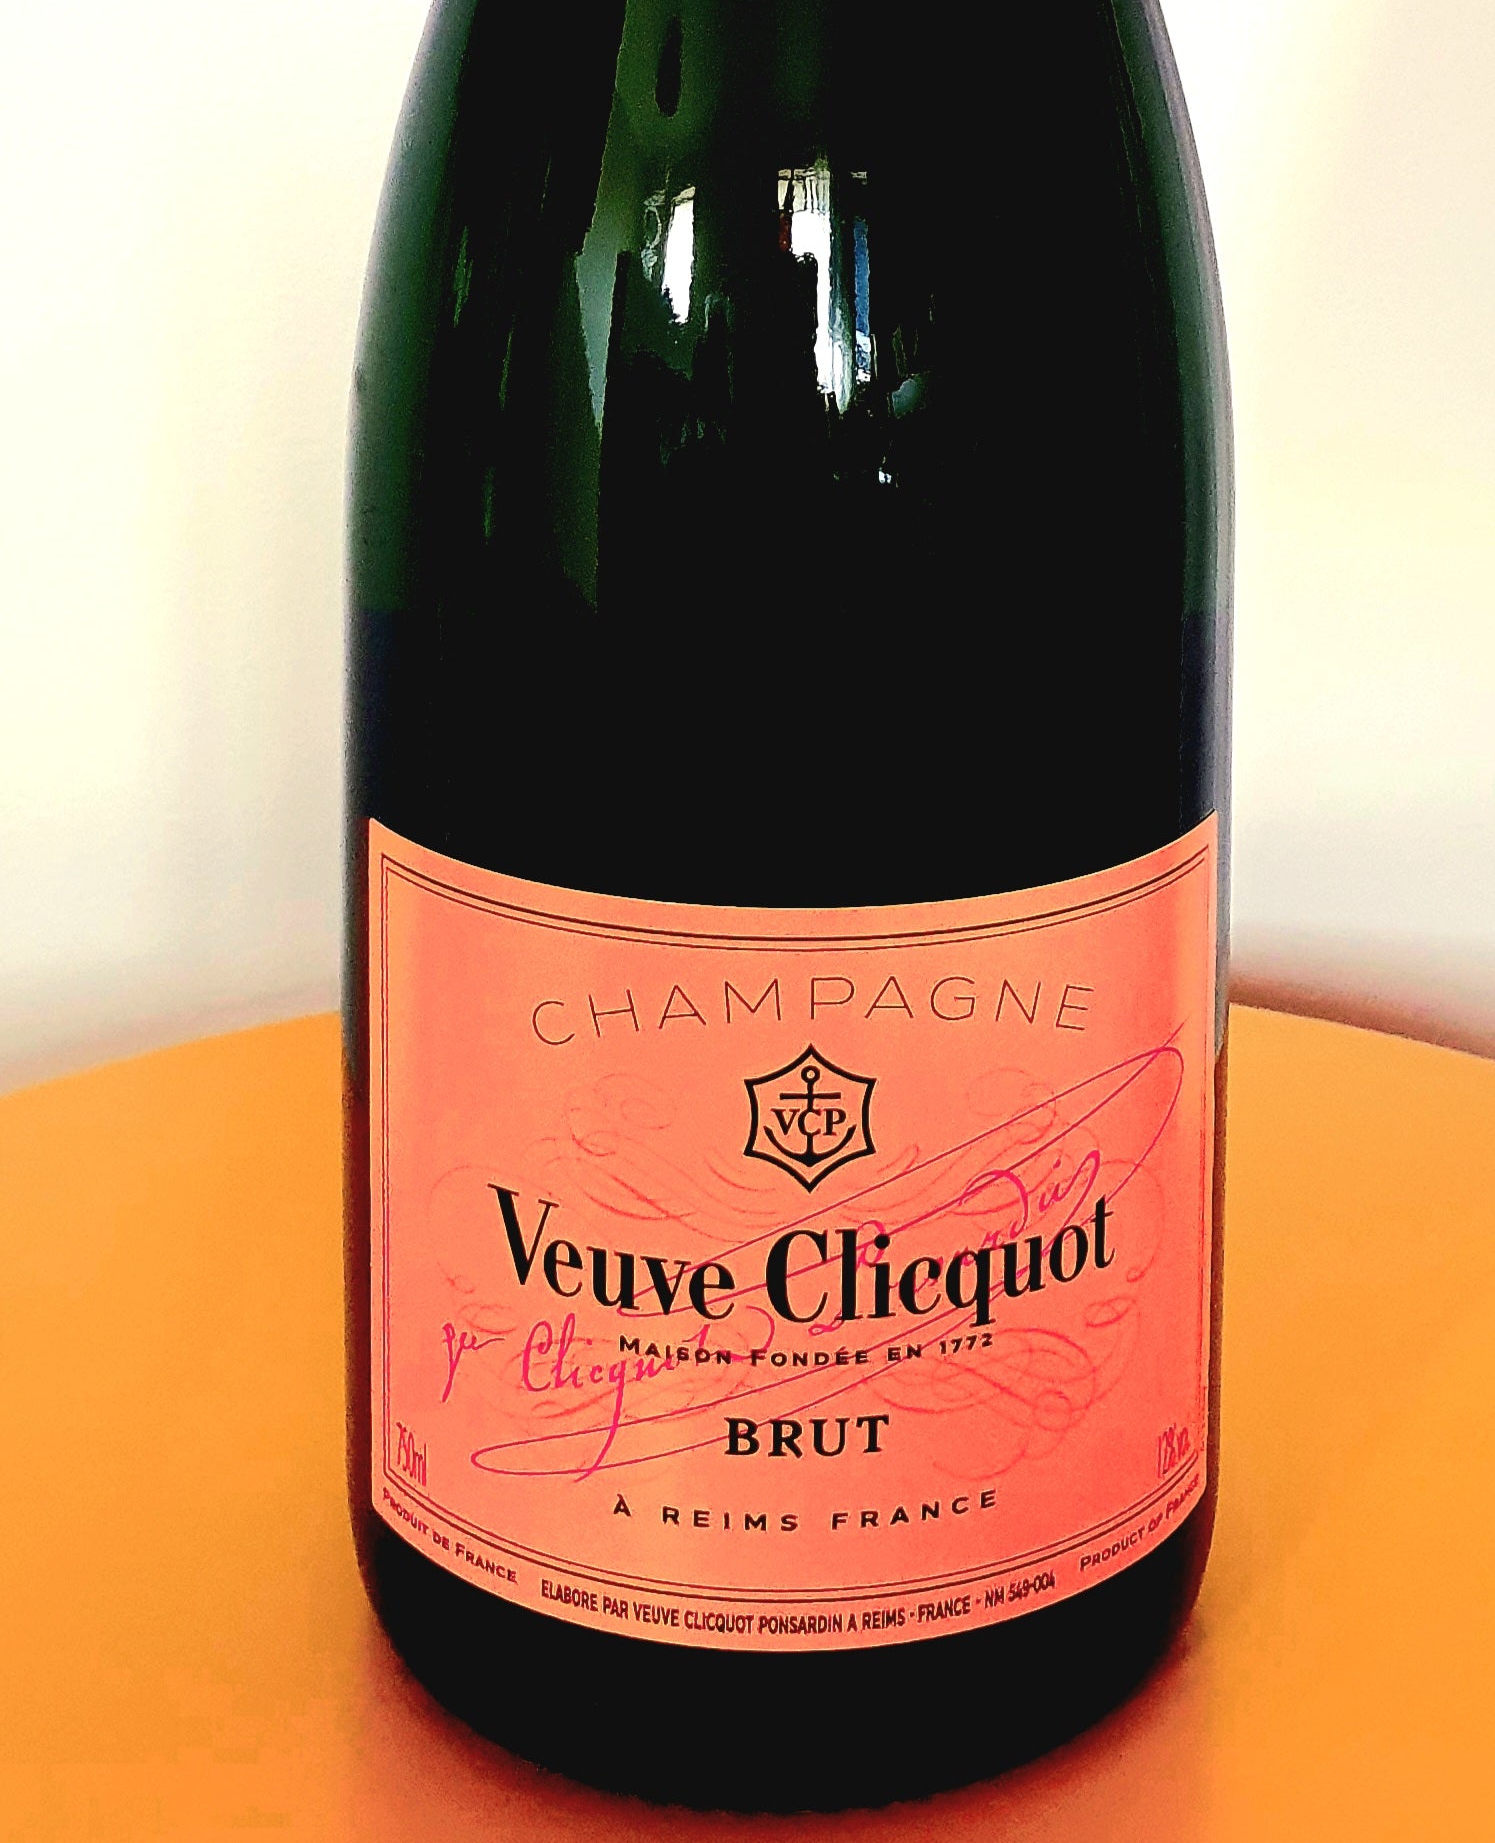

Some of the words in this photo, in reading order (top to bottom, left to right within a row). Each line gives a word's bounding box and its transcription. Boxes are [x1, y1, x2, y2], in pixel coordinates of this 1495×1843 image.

[532, 976, 1094, 1046] CHAMPAGNE
[771, 1107, 848, 1137] VCP
[487, 1183, 736, 1320] Veuve
[765, 1195, 1116, 1329] Clicquot
[750, 1345, 870, 1367] FONDÉE
[887, 1343, 922, 1363] EN
[939, 1332, 993, 1355] 1772
[724, 1414, 890, 1459] BRUT
[382, 1486, 430, 1535] PRODUIT
[432, 1528, 451, 1551] DE
[455, 1542, 517, 1584] FRANCE
[613, 1493, 632, 1517] À
[661, 1505, 799, 1532] REIMS
[831, 1489, 997, 1531] FRANCE
[1080, 1526, 1145, 1571] PRODUCT
[1147, 1512, 1163, 1533] OF
[541, 1579, 599, 1613] ELABORE
[602, 1595, 629, 1619] PAR
[632, 1602, 680, 1627] VEUVE
[684, 1611, 755, 1634] CLICQUOT
[758, 1614, 842, 1634] PONSARDIN
[862, 1607, 905, 1630] REIMS
[916, 1595, 971, 1623] FRANCE
[984, 1585, 1005, 1609] NM
